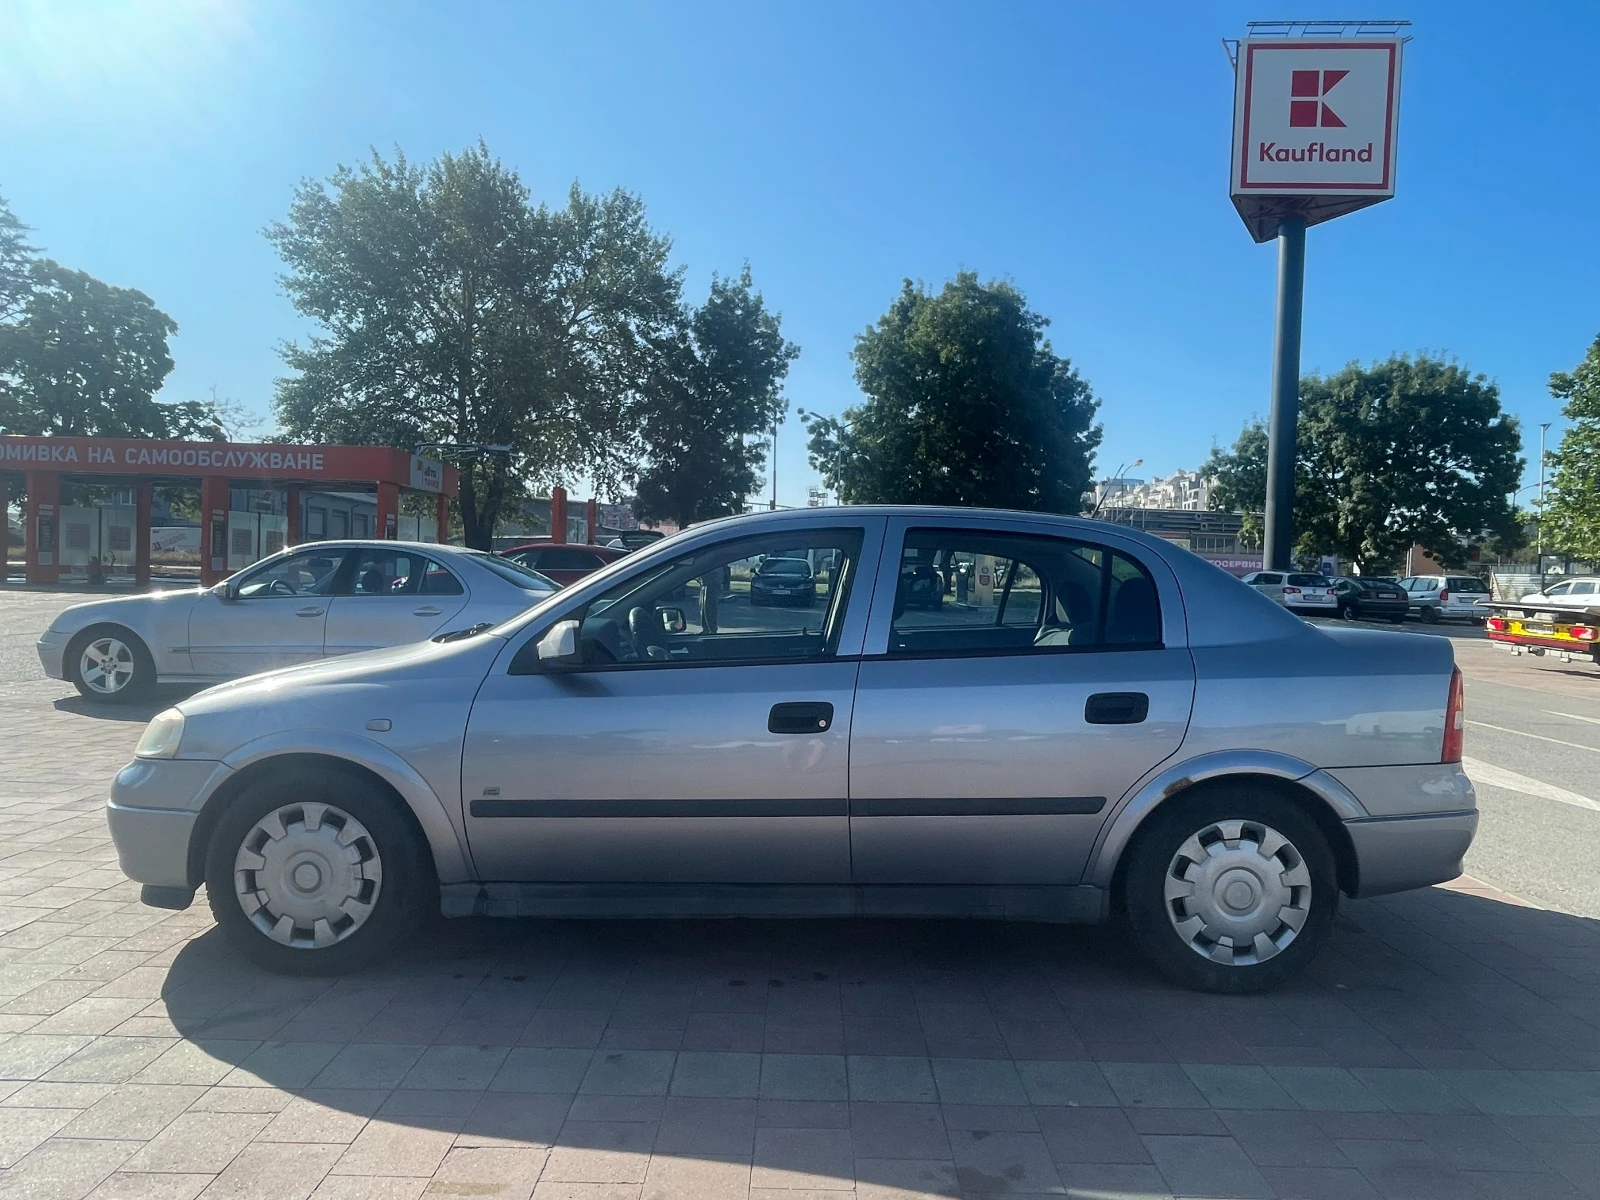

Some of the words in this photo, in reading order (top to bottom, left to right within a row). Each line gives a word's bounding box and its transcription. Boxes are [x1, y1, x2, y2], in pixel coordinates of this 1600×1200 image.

[1259, 142, 1373, 163] Kaufland
[88, 446, 116, 463] НА
[125, 448, 324, 470] САМООБСЛУЖВАНЕ
